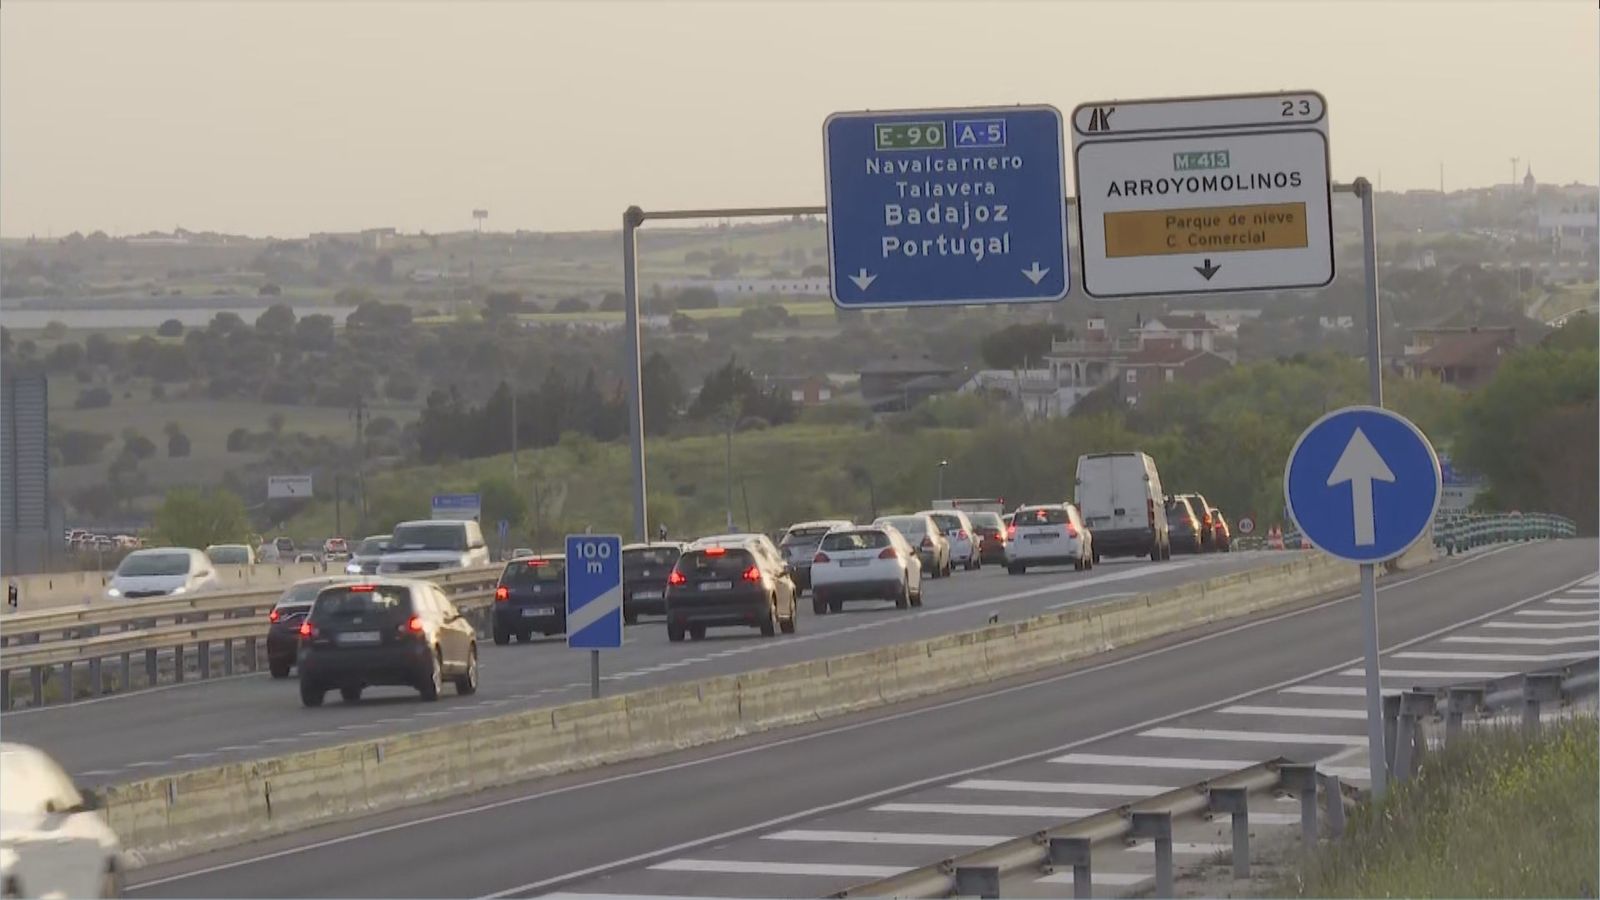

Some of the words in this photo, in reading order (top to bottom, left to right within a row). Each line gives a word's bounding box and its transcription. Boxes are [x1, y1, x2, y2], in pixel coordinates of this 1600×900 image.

[1281, 100, 1311, 117] 23
[879, 126, 941, 146] E-90
[960, 125, 1001, 143] A-5
[866, 155, 1023, 175] Navalcarnero
[1175, 152, 1228, 170] M-413
[896, 180, 996, 199] Talavera
[1107, 171, 1302, 198] ARROYOMOLINOS
[884, 201, 1009, 231] Badajoz
[1166, 213, 1221, 231] Parque
[1228, 212, 1246, 227] de
[1253, 211, 1294, 226] nieve
[881, 232, 1010, 262] Portugal
[1188, 231, 1266, 247] Comercial
[575, 542, 611, 560] 100
[586, 561, 603, 575] m
